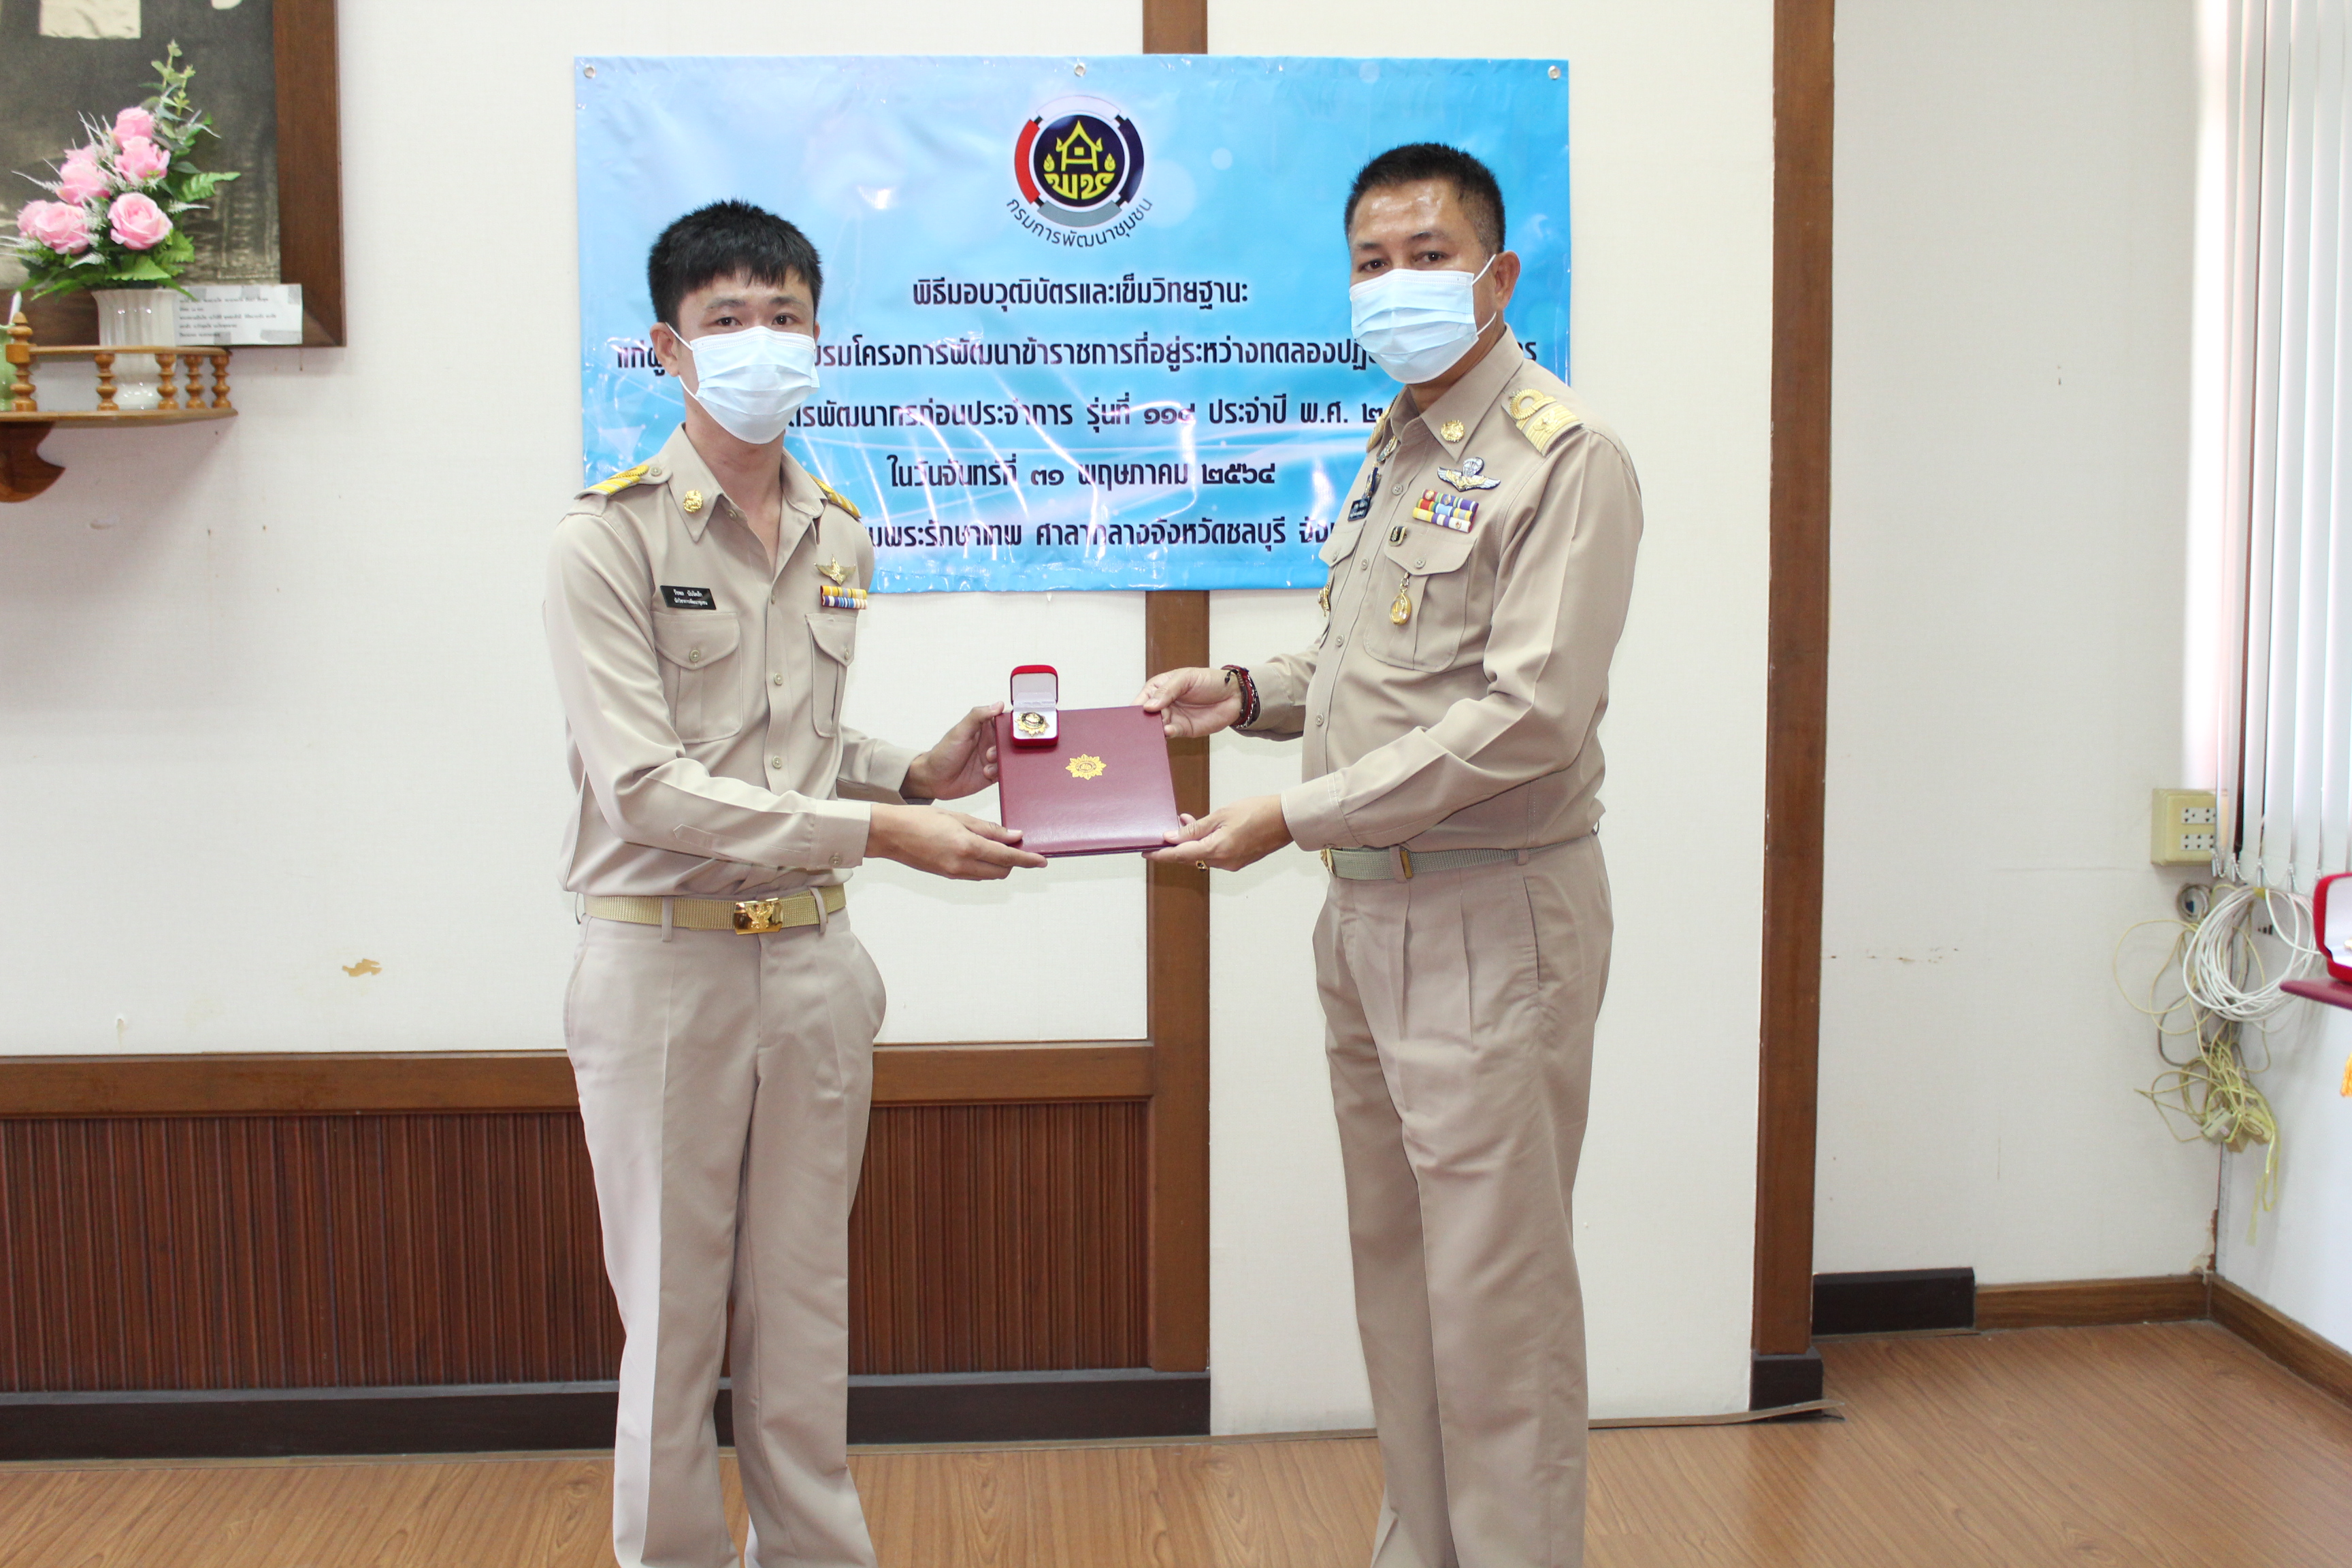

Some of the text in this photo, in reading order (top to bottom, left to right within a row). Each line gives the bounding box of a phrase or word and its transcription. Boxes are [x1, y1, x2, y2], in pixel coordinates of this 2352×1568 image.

[1007, 198, 1153, 248] กรมการพัฒนาชุมชน
[913, 273, 1248, 312] พิธีมอบวุฒิบัตรและเข็มวิทยฐานะ
[617, 340, 666, 376] แก่ผู
[815, 331, 1376, 372] รมโครงการพัฒนาข้าราชการที่อยู่ระหว่างทดลองปฏ
[1087, 392, 1130, 434] รุ่นที่
[1209, 393, 1287, 424] ประจำปี
[1301, 401, 1348, 423] พ.ศ.
[1030, 468, 1064, 486] ๓๑
[1077, 463, 1188, 491] พฤษภาคม
[1201, 463, 1275, 485] ๒๕๖๔
[1036, 516, 1286, 552] ศาลากลางจังหวัดชลบุรี
[1298, 516, 1335, 544] จัง
